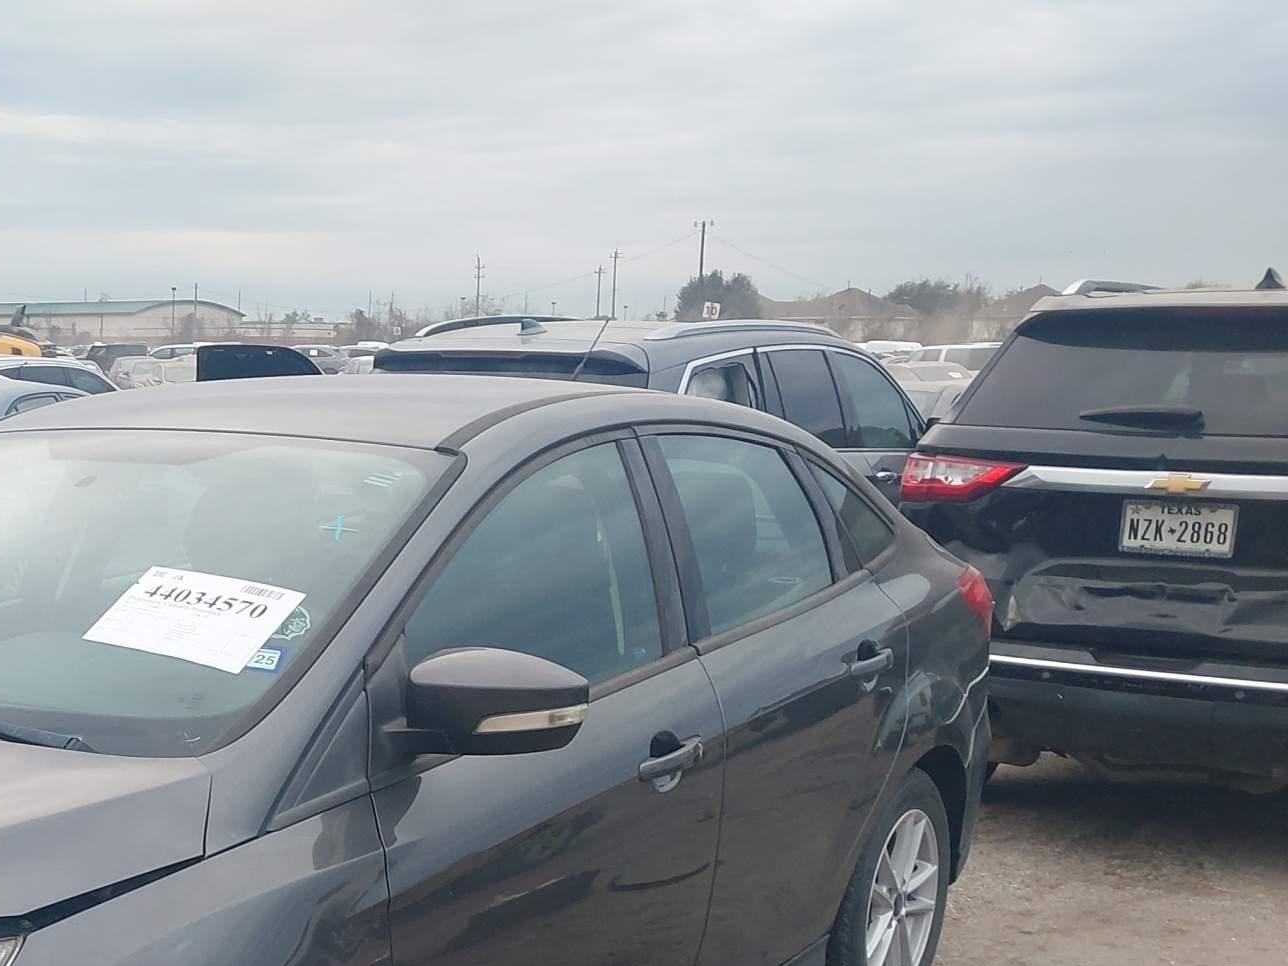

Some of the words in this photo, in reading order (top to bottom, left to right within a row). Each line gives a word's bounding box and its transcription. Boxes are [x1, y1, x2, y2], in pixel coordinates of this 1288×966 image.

[1160, 505, 1202, 516] TEXAS
[144, 584, 268, 619] 44034570
[253, 654, 276, 666] 25
